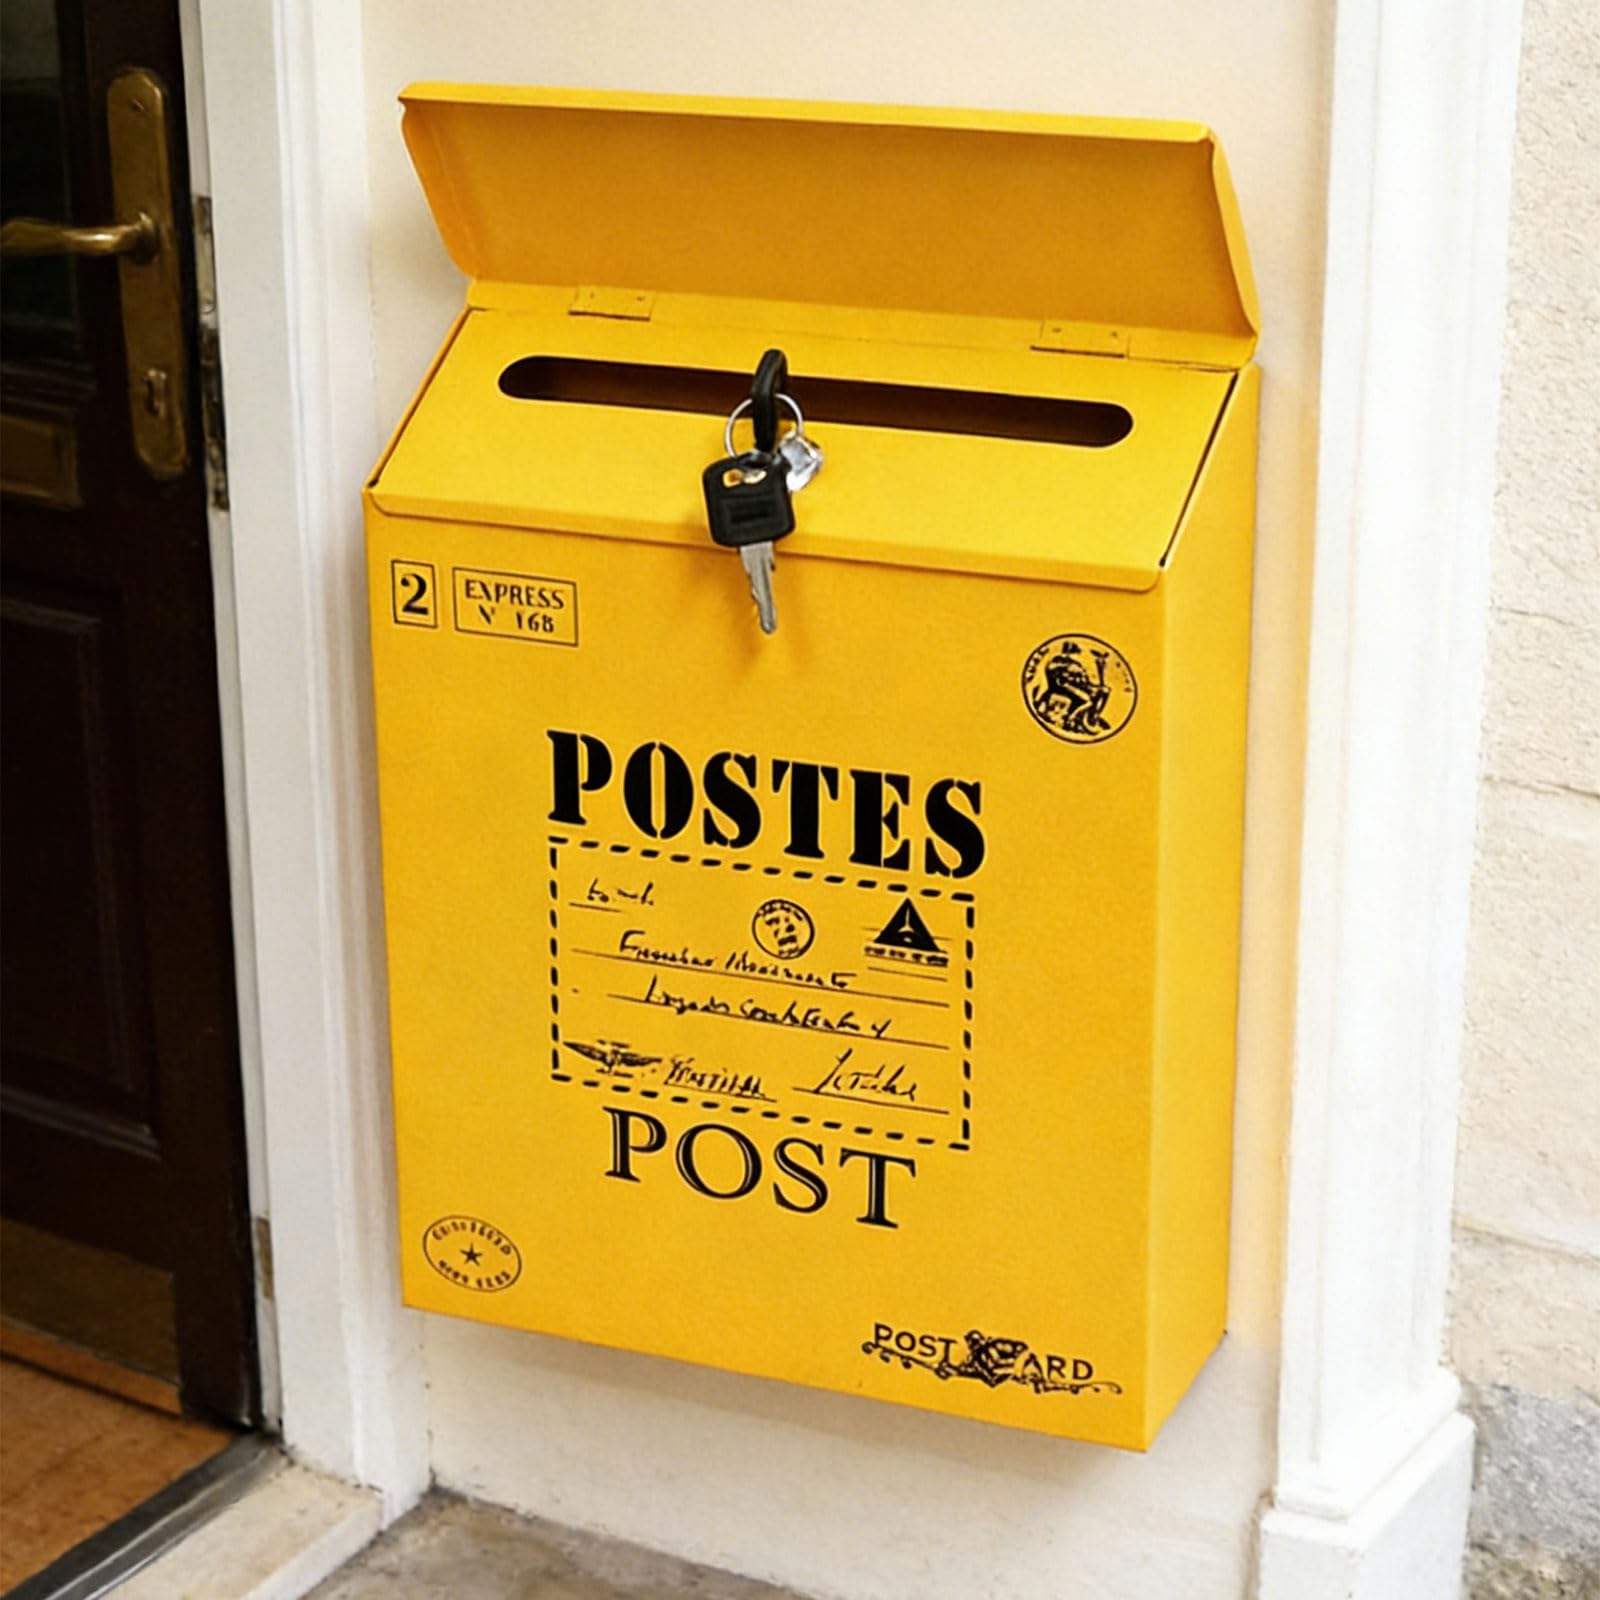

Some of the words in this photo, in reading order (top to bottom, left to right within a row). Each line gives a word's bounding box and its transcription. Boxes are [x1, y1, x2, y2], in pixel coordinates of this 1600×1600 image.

[401, 573, 429, 615] 2
[465, 579, 565, 610] EXPRESS
[515, 609, 555, 633] 168
[546, 729, 986, 879] POSTES
[602, 1106, 917, 1229] POST
[873, 1322, 957, 1366] POST
